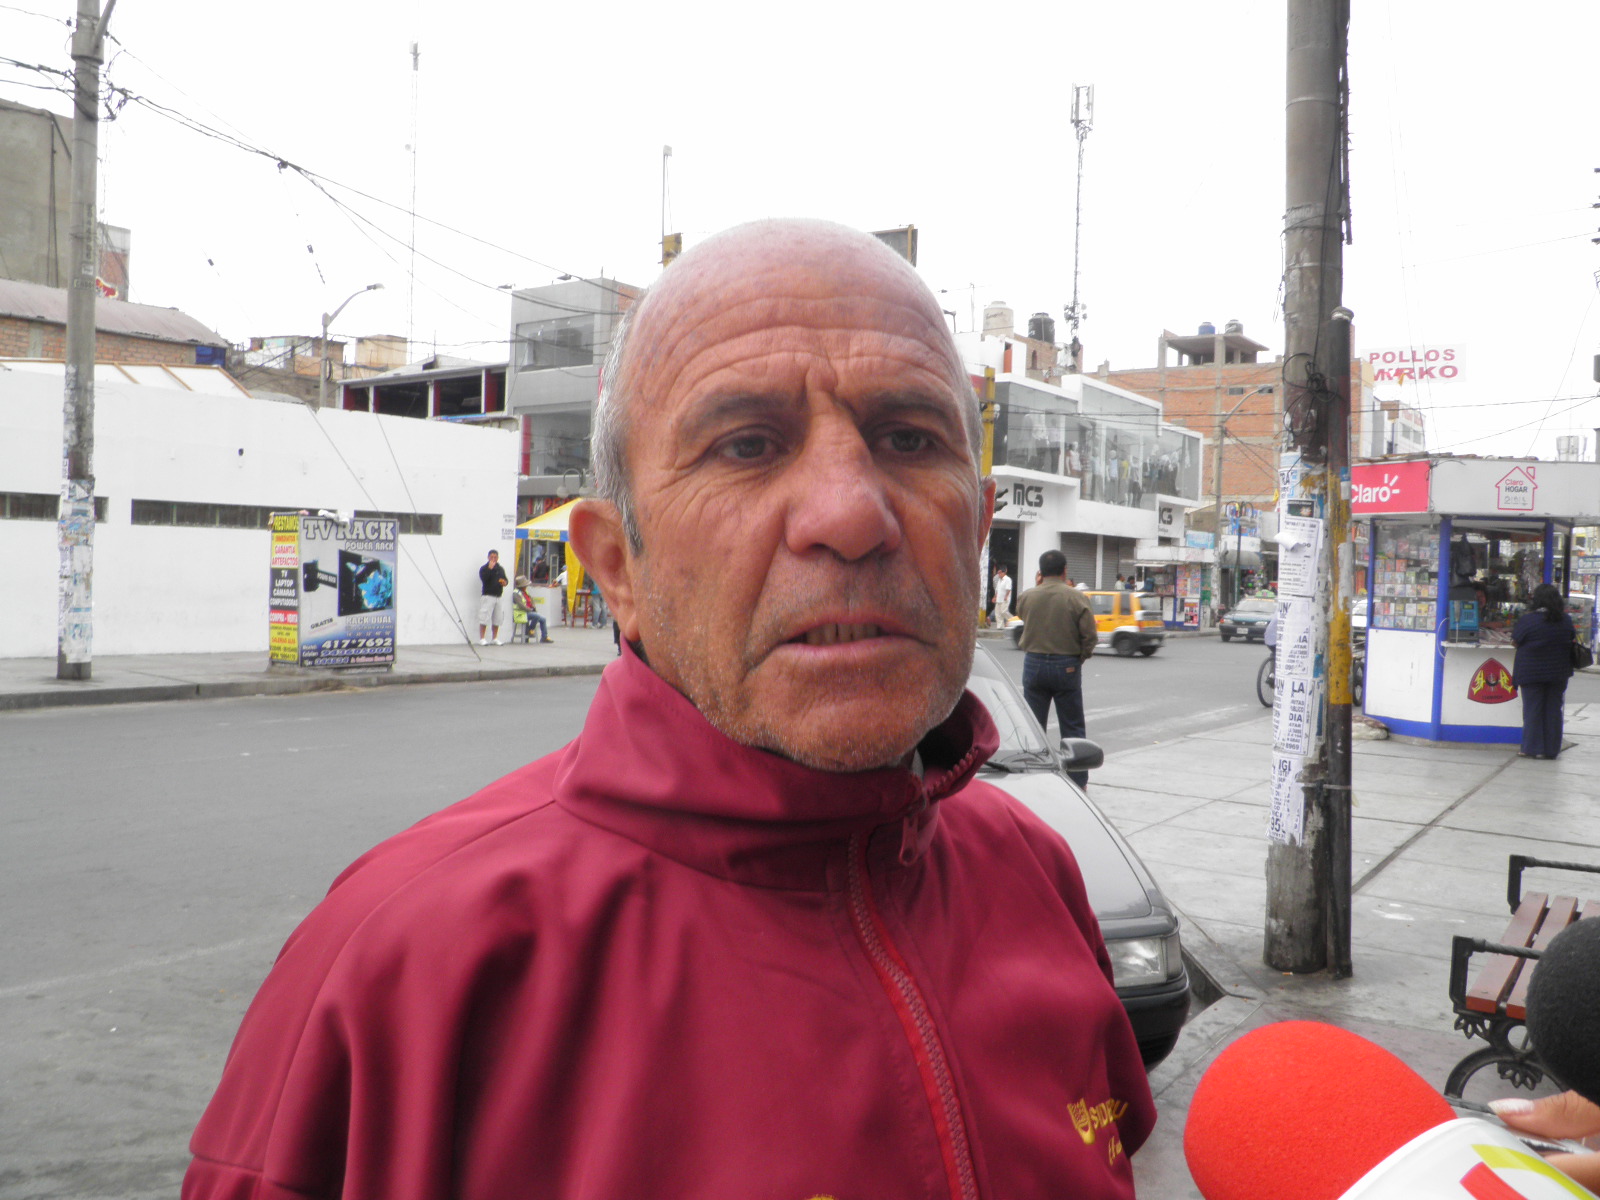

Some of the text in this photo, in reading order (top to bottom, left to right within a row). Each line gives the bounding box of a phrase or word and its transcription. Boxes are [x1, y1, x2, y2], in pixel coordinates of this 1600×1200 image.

[1369, 349, 1455, 364] POLLOS
[303, 518, 395, 541] TV RACK
[345, 541, 395, 552] POWER RACK
[275, 579, 294, 588] LAPTOP
